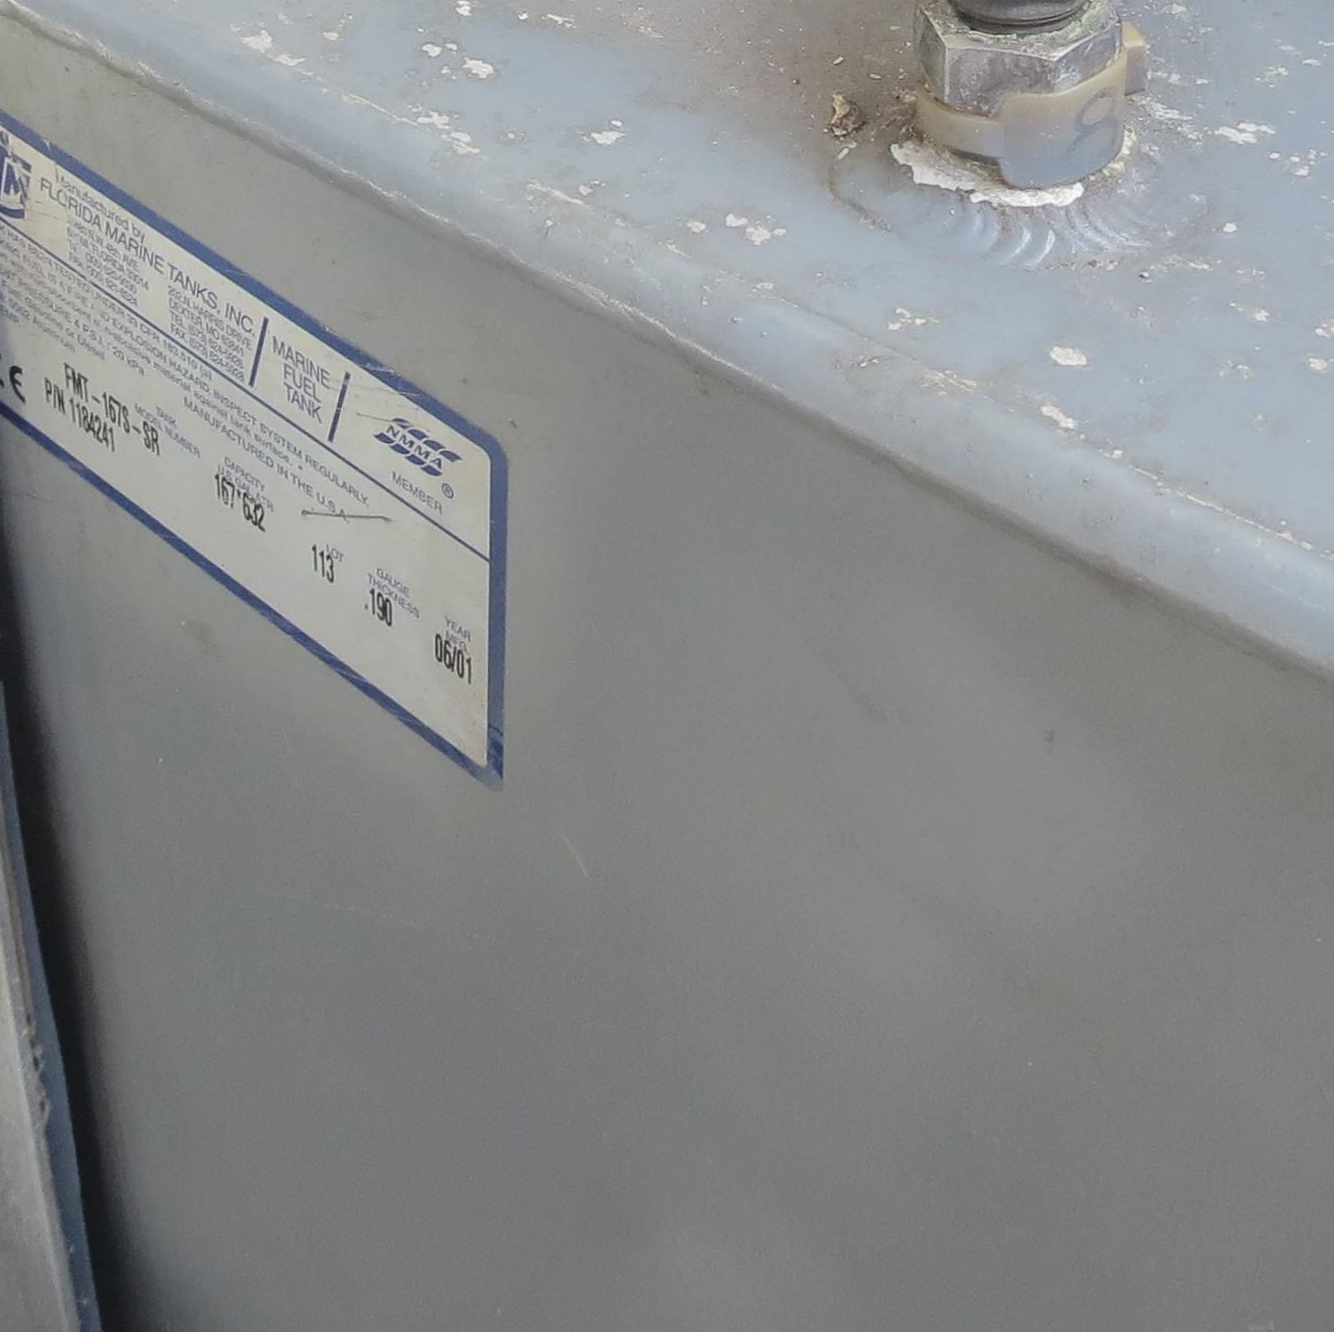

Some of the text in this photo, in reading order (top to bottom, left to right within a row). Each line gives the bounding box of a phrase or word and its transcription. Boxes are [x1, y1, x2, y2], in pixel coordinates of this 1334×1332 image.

[40, 177, 102, 231] FLORIDA
[105, 221, 164, 275] MARINE
[168, 262, 220, 315] TANKS,
[225, 303, 255, 336] INC.
[131, 223, 145, 244] by
[139, 320, 160, 344] CFR
[206, 322, 219, 342] MO
[225, 323, 252, 353] DRIVE
[272, 332, 330, 390] MARINE
[282, 360, 321, 405] FUEL
[43, 376, 115, 453] P/N 1184241
[112, 316, 166, 365] EXPLOSION
[213, 387, 256, 429] INSPECT
[259, 420, 302, 461] SYSTEM
[305, 452, 369, 509] REGULARLY.
[282, 380, 323, 426] TANK
[183, 395, 273, 469] MANUFACTURED
[276, 460, 289, 481] IN
[291, 471, 313, 499] THE
[385, 420, 443, 471] NMMA
[223, 454, 265, 494] CAPACITY
[392, 469, 442, 516] MEMBER
[310, 541, 334, 585] 113
[326, 542, 343, 565] LOT
[363, 580, 393, 629] .190
[367, 571, 419, 619] THICKNESS
[444, 614, 471, 643] YEAR
[434, 630, 472, 686] 06/01
